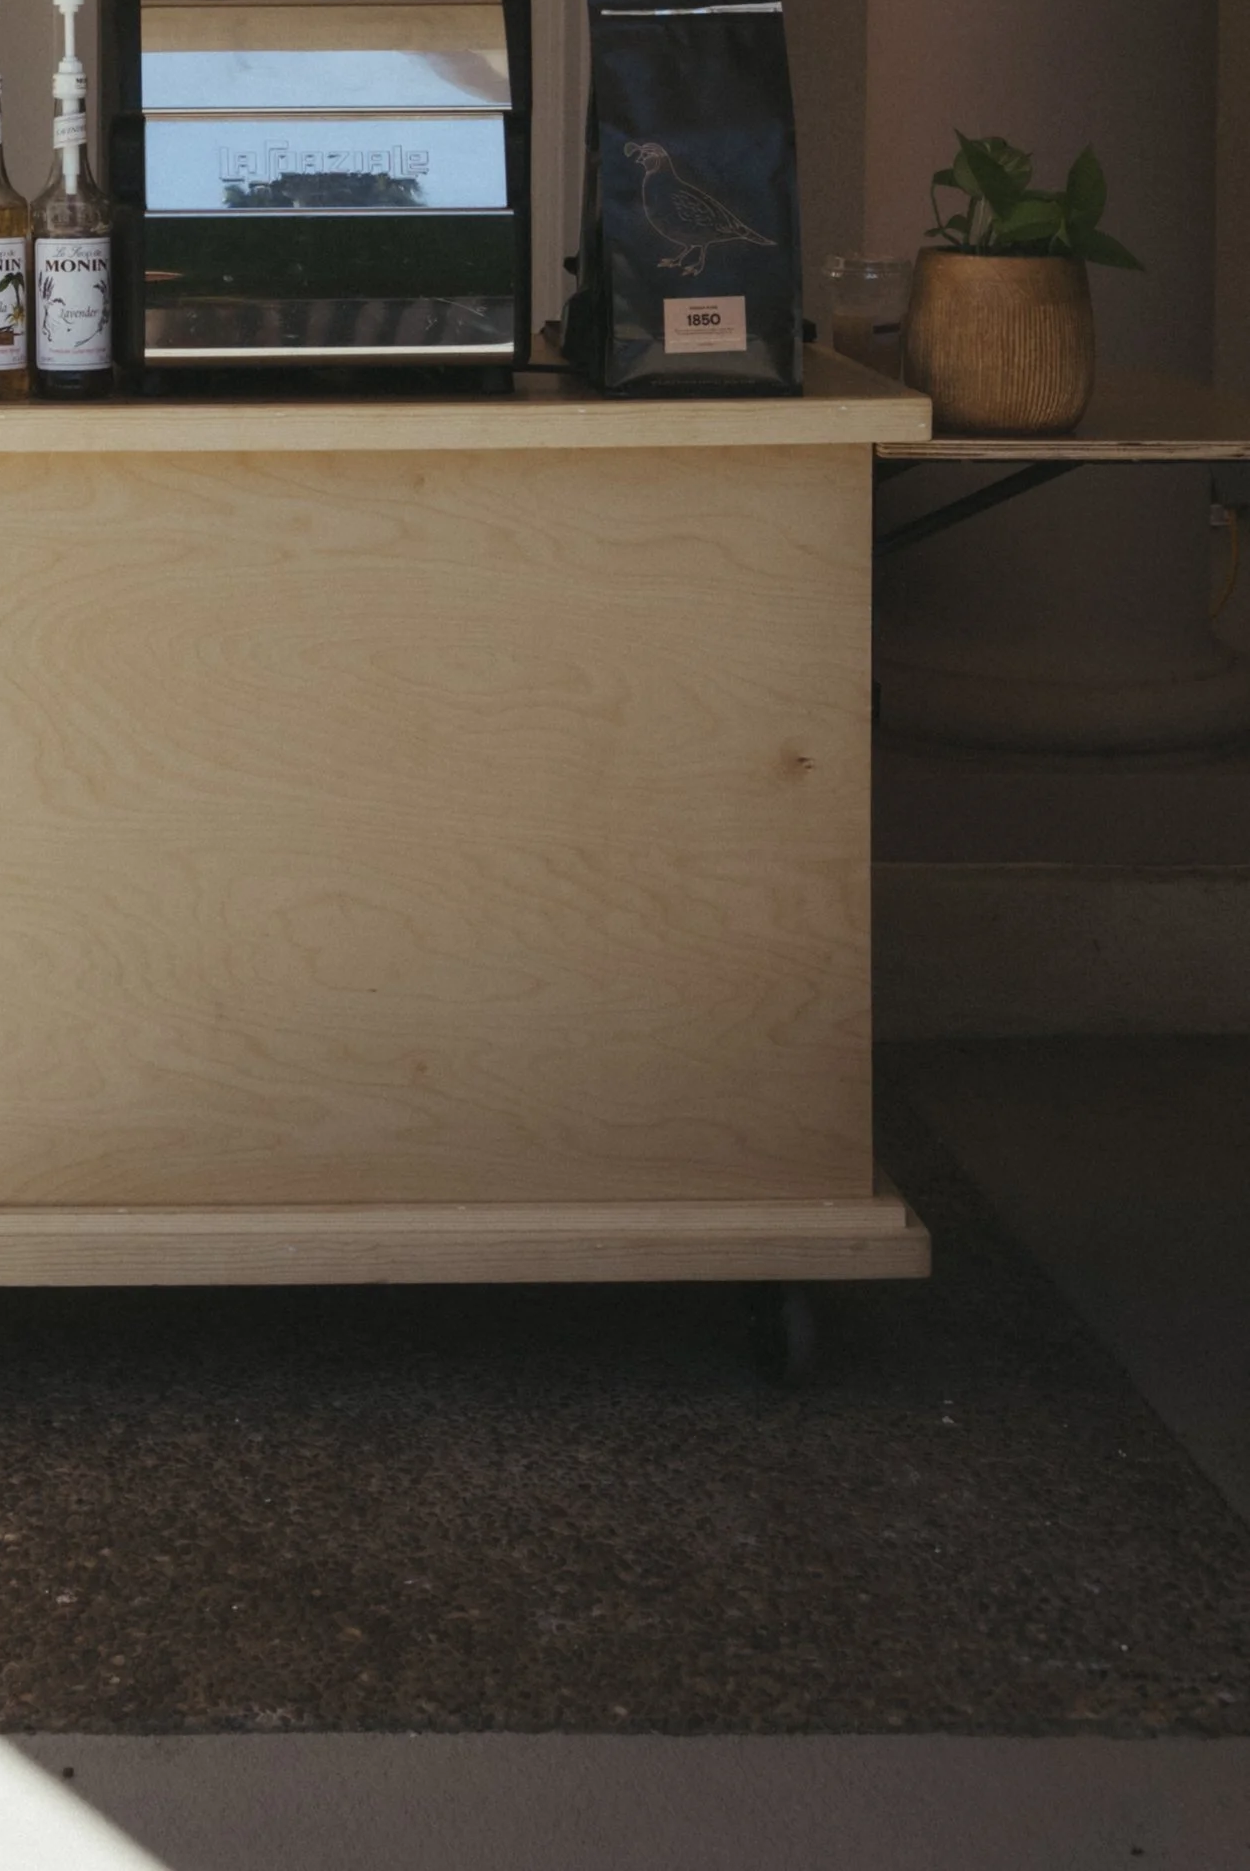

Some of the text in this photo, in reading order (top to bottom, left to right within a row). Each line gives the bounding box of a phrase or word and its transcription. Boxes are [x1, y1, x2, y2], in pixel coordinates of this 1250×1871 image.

[45, 257, 109, 273] MONIN
[58, 305, 99, 325] Lavender
[686, 312, 721, 327] 1850
